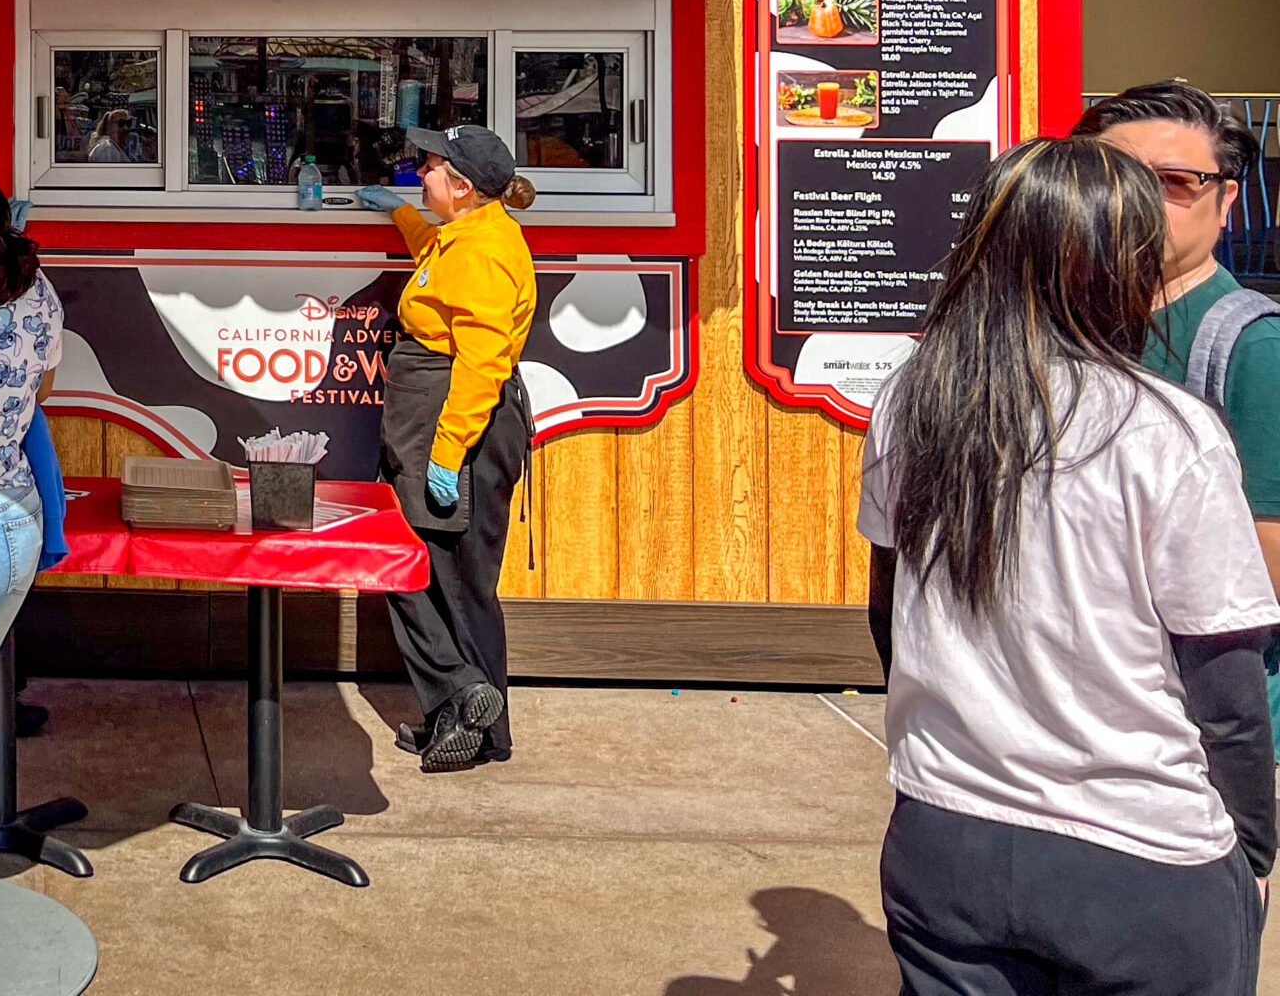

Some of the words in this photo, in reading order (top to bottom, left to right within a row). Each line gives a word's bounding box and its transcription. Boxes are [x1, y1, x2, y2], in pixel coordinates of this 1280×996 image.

[895, 46, 927, 54] Pineapple
[929, 46, 952, 54] Wedge
[882, 71, 910, 79] Estrella
[912, 71, 937, 79] Jalisco
[938, 71, 977, 79] Michelada
[882, 90, 914, 98] garnished
[814, 149, 849, 159] Estrella
[852, 149, 882, 159] Jalisco
[885, 149, 922, 159] Mexican
[925, 149, 951, 160] Lager
[846, 161, 877, 170] Mexico
[879, 161, 898, 170] ABV
[900, 161, 921, 170] 4.5%
[872, 172, 896, 180] 14.50
[794, 192, 829, 201] Festival
[831, 192, 852, 201] Beer
[855, 192, 882, 203] Flight
[951, 194, 971, 202] 18.0
[794, 209, 822, 217] Russian
[824, 209, 844, 217] River
[846, 209, 866, 217] Blind
[868, 209, 880, 218] Pig
[882, 209, 895, 217] IPA
[806, 240, 835, 248] Bodega
[794, 270, 821, 279] Golden
[824, 270, 842, 279] Road
[845, 270, 861, 279] Ride
[864, 270, 875, 279] On
[877, 270, 907, 281] Tropical
[909, 270, 928, 281] Hazy
[930, 270, 943, 279] IPA
[794, 301, 815, 310] Study
[295, 293, 379, 329] Disney
[218, 328, 335, 343] CALIFORNIA
[343, 330, 404, 344] ADVEN
[217, 348, 328, 383] FOOD
[333, 353, 358, 382] &
[823, 360, 871, 370] smartwater
[875, 362, 892, 370] 5.75
[290, 389, 385, 405] FESTIVAL
